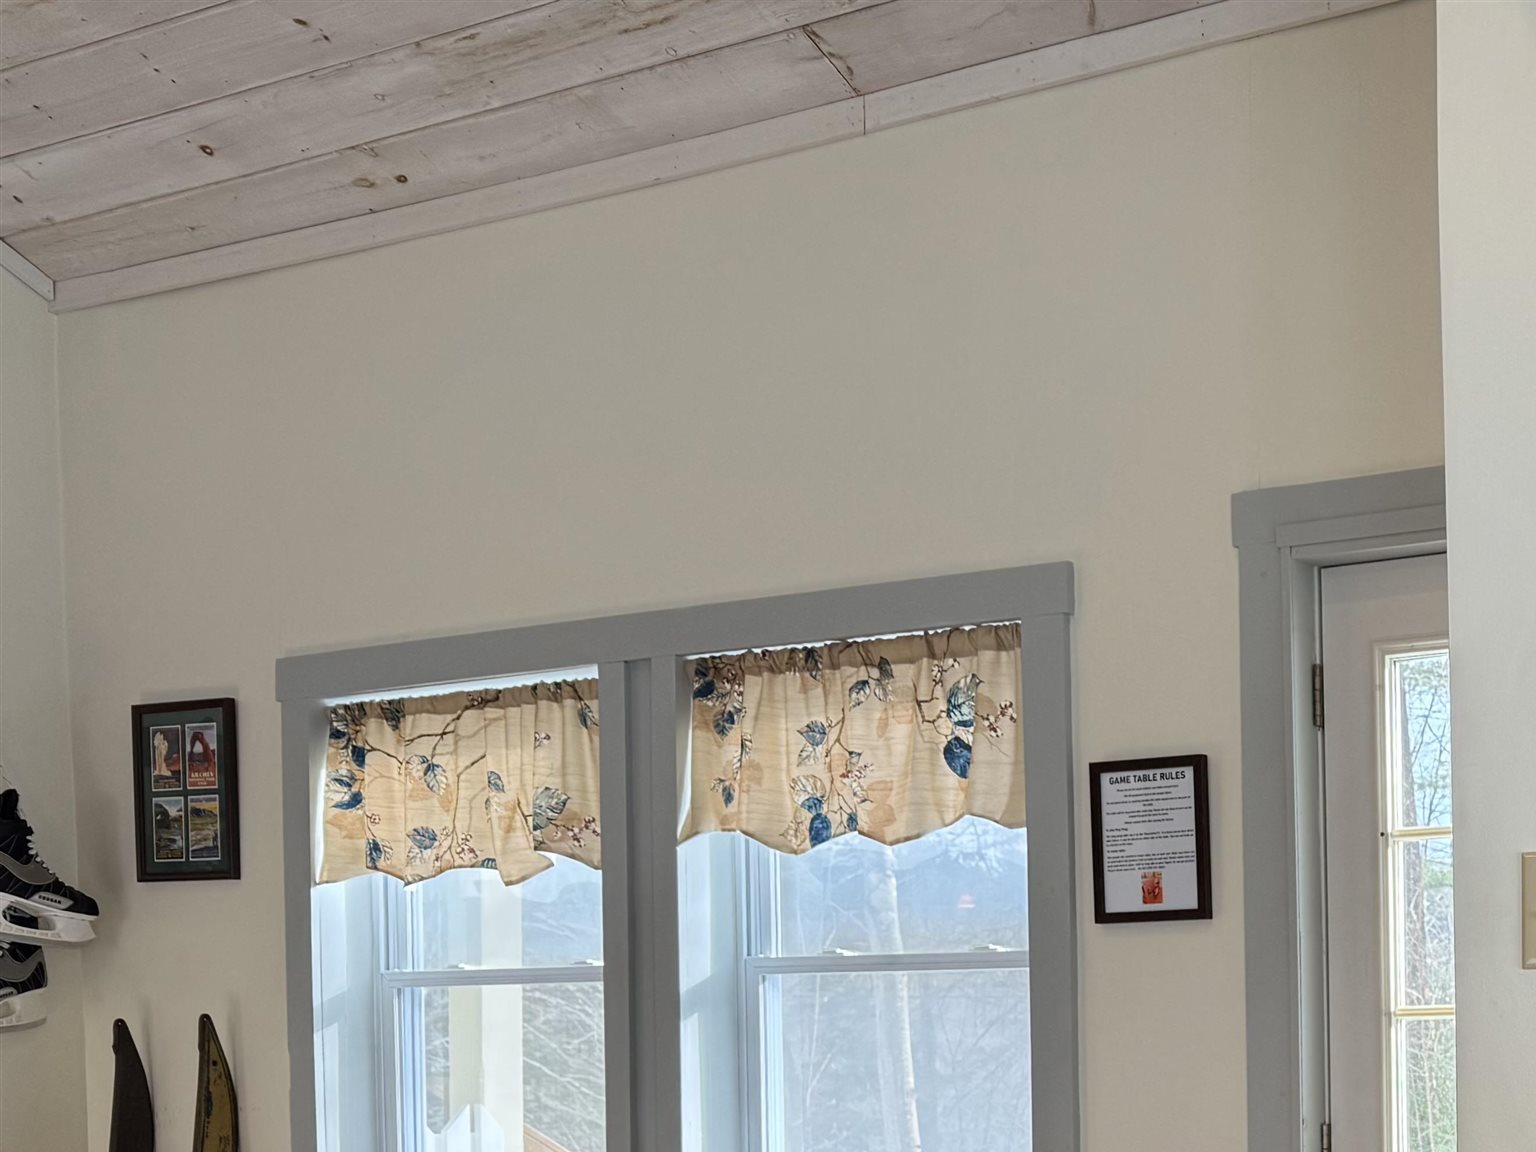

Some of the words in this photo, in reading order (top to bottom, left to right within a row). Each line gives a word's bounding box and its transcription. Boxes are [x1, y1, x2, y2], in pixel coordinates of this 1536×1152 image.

[1109, 775, 1131, 785] GAME
[1133, 773, 1158, 783] TABLE
[1159, 770, 1186, 781] RULES
